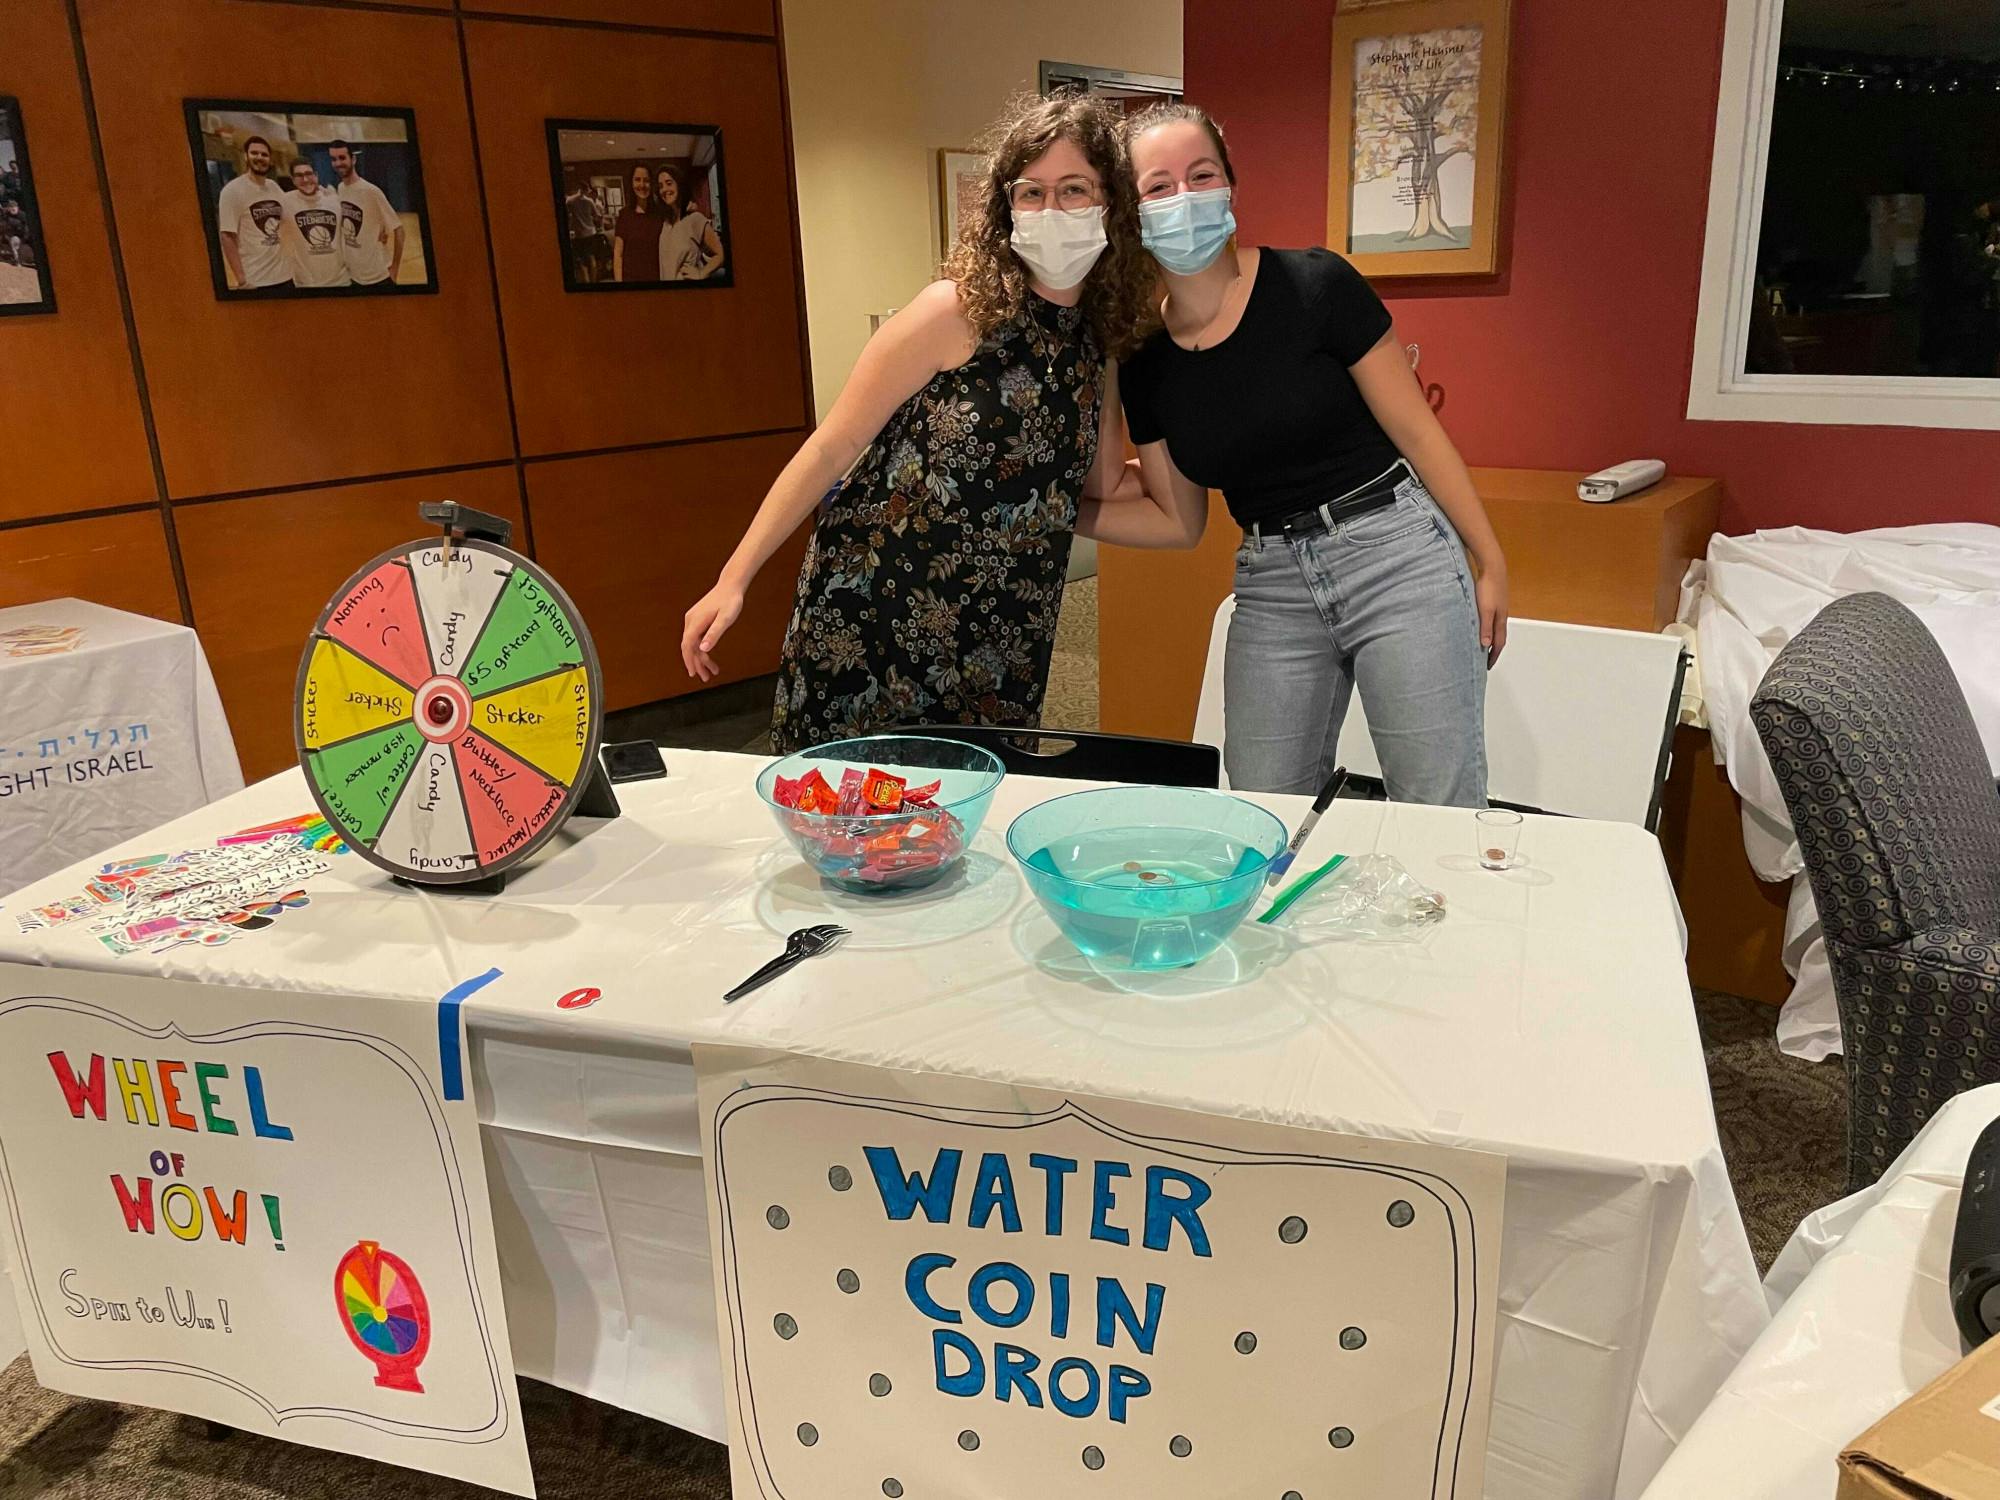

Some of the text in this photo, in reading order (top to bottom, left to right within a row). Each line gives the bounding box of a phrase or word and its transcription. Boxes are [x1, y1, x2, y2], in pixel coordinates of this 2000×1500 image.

[1370, 50, 1418, 66] Stephanie
[1414, 59, 1423, 71] of
[1426, 58, 1443, 70] Life
[422, 550, 473, 574] Cady
[333, 577, 385, 627] Nothing
[518, 575, 576, 649] $5 giftcard
[440, 611, 466, 666] Candy
[468, 619, 541, 686] $5 giftcard
[306, 677, 318, 739] Sticker
[344, 691, 403, 716] Sticker
[486, 703, 546, 726] Sticker
[574, 683, 587, 751] Sticker
[38, 724, 149, 758] תגלית
[66, 750, 153, 783] ISRAEL
[387, 744, 415, 783] Coffee
[418, 753, 447, 812] Candy
[468, 768, 515, 828] Necklace
[409, 848, 466, 870] Candy
[47, 1051, 294, 1141] WHEEL
[149, 1150, 186, 1177] OF
[110, 1174, 286, 1251] WOW!
[862, 1146, 1213, 1257] WATER
[136, 1297, 164, 1323] to
[905, 1252, 1166, 1355] COIN
[933, 1328, 1152, 1424] DROP
